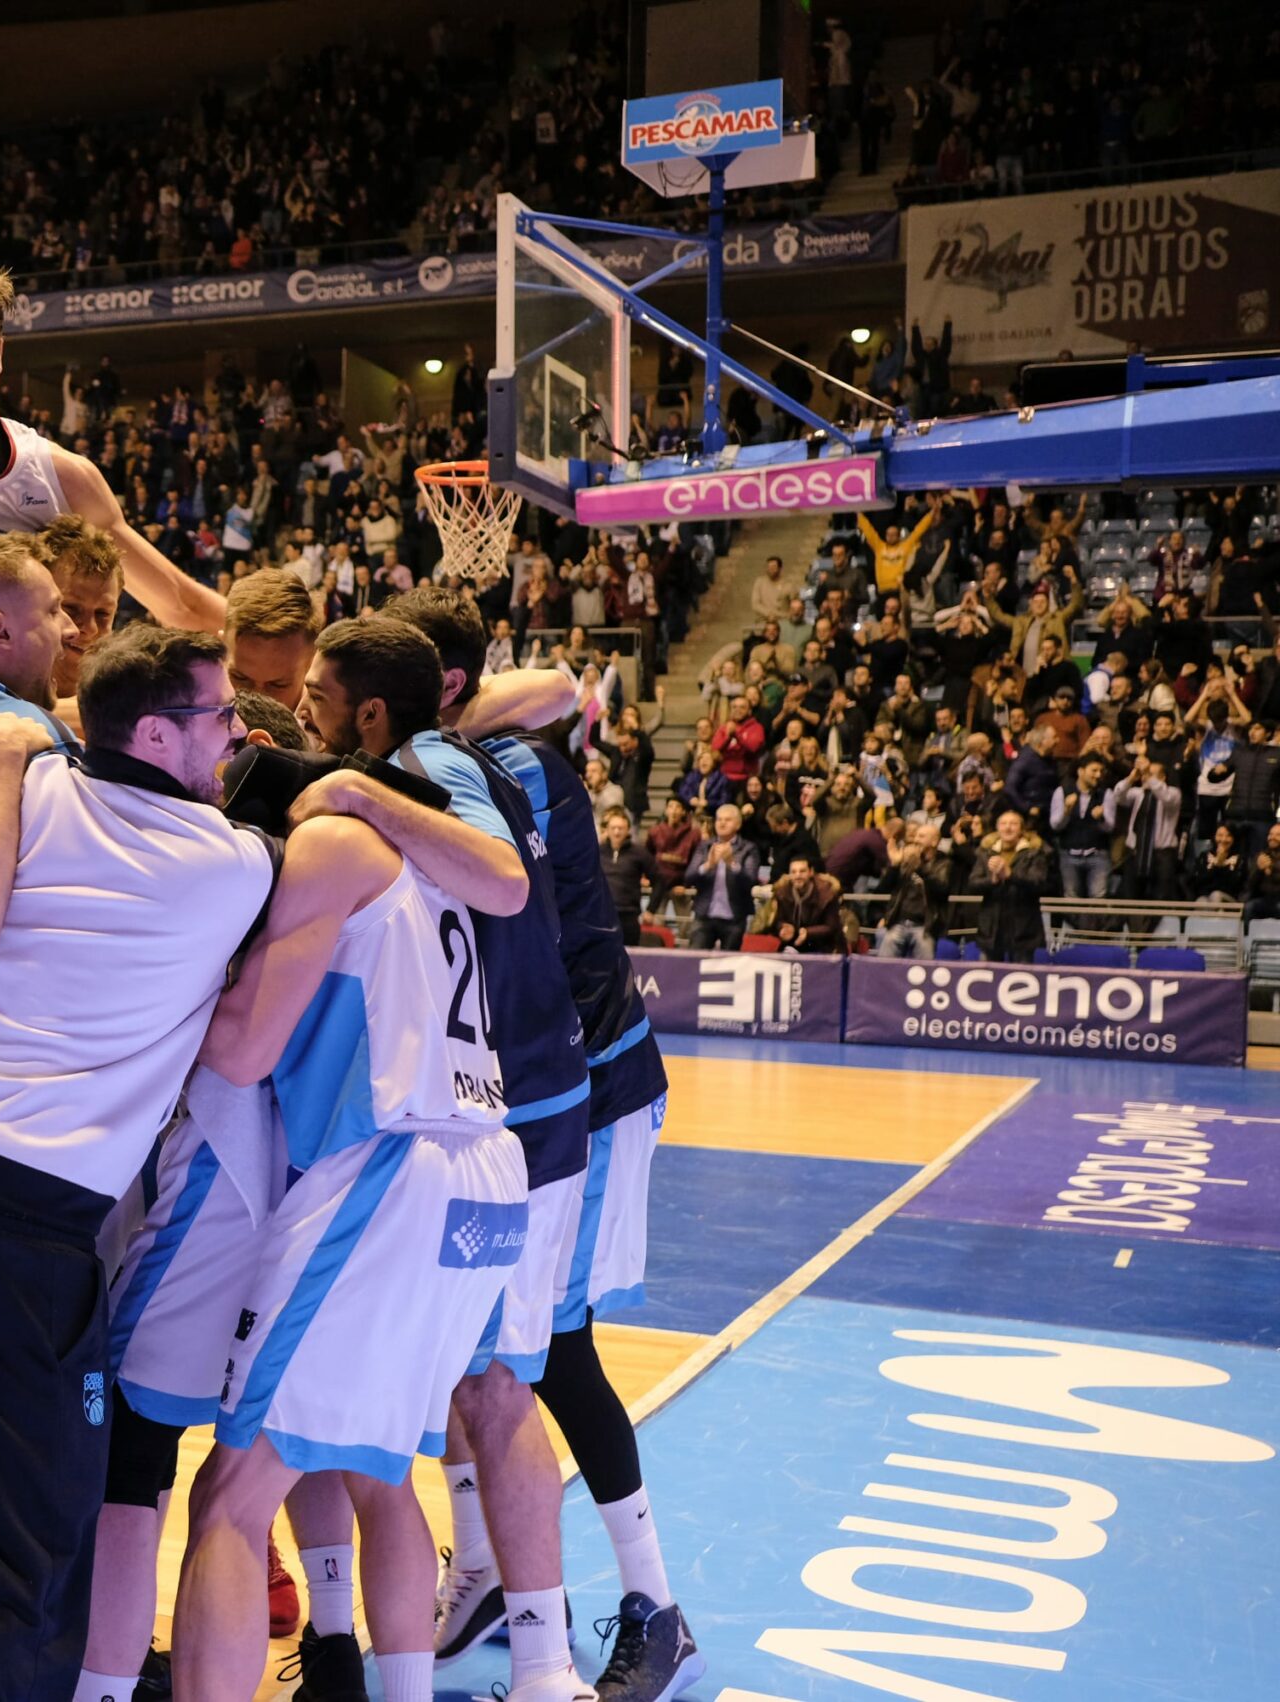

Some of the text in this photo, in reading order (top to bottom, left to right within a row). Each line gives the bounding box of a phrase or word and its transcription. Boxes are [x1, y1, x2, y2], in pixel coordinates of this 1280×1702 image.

[629, 107, 777, 149] PESCAMAR
[1073, 227, 1229, 283] XUNTOS
[81, 289, 154, 311] cenor
[189, 280, 265, 303] cenor
[1073, 275, 1187, 326] OBRA!
[663, 468, 872, 515] endesa
[956, 968, 1180, 1024] cenor
[903, 1013, 1178, 1054] electrodomésticos
[714, 1453, 1118, 1702] mov
